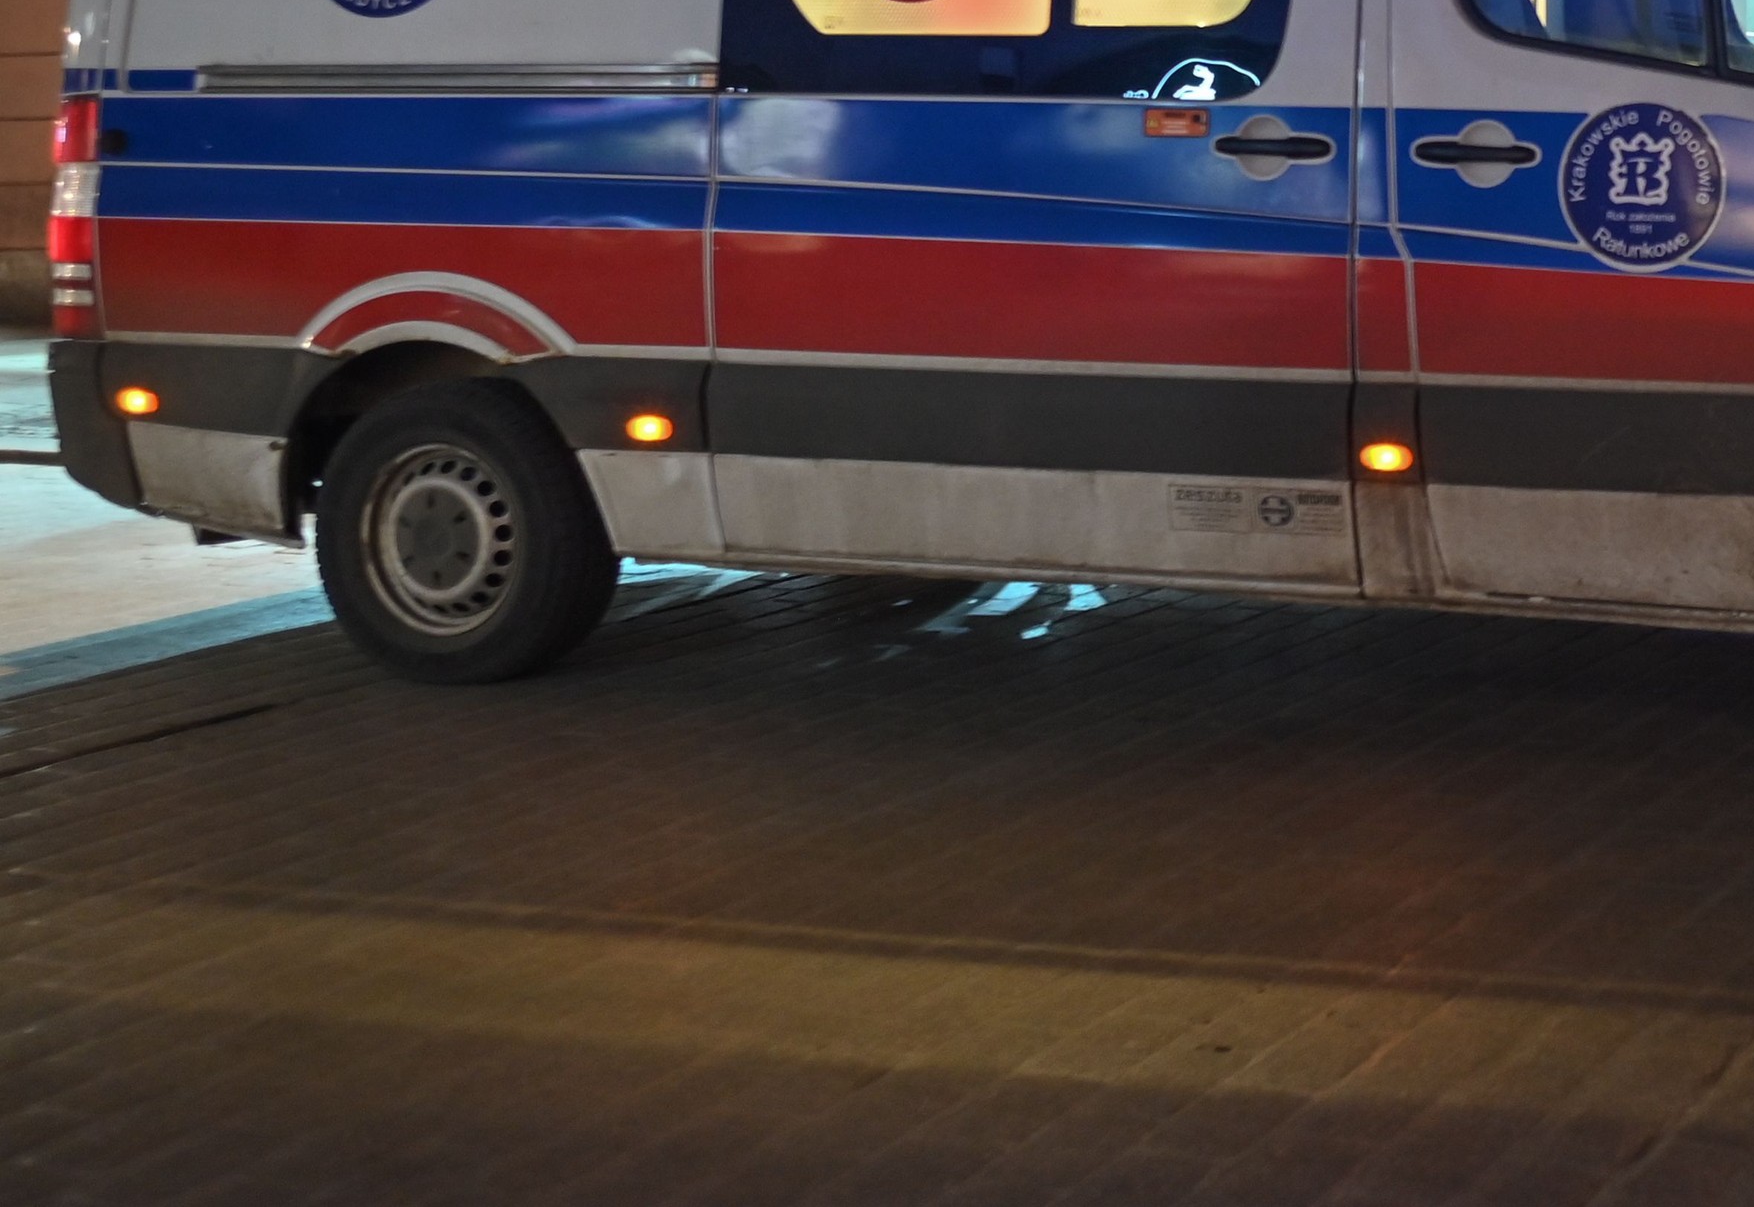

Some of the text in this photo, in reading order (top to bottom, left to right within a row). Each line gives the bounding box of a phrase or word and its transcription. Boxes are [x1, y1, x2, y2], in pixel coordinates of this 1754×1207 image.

[1567, 109, 1717, 206] Krakowskie Pogotowie
[1592, 226, 1690, 260] Ratunkowe
